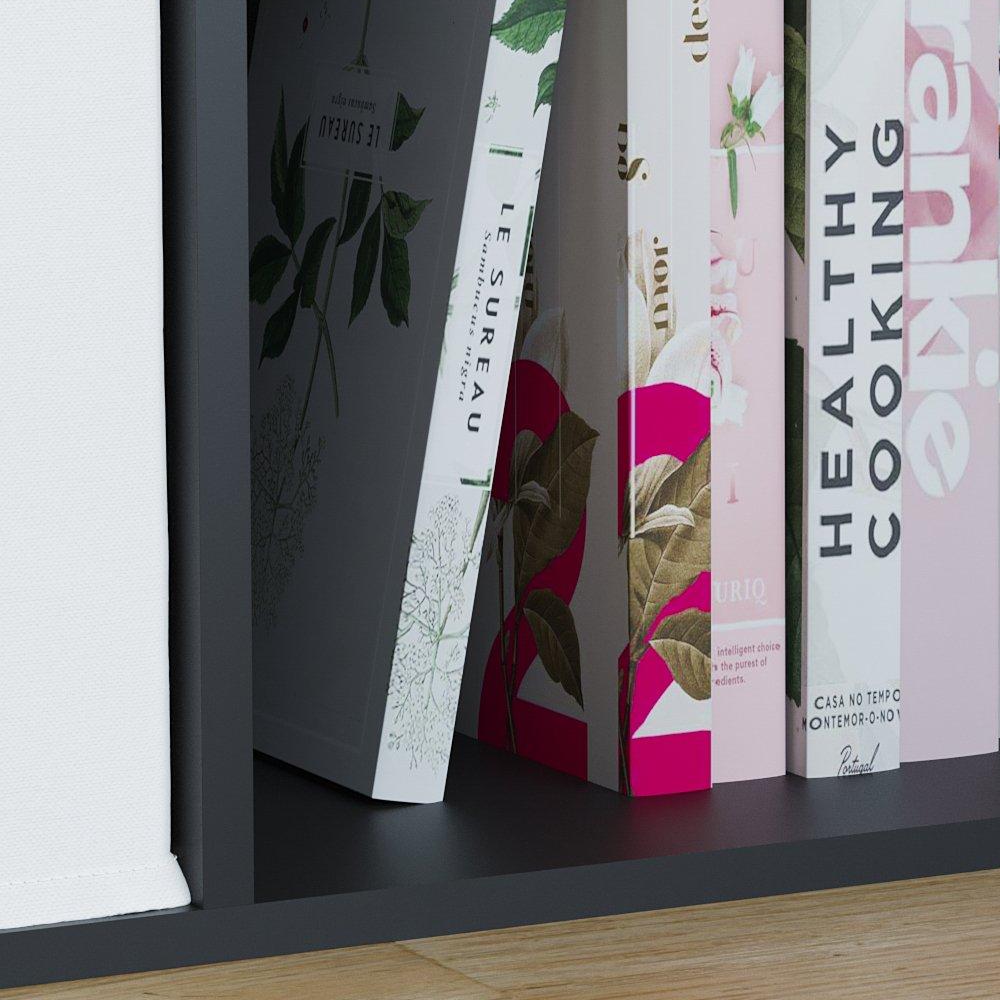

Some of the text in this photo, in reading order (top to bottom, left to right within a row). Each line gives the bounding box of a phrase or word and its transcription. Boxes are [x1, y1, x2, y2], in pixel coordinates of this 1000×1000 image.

[317, 115, 381, 149] LE SUREAU
[457, 230, 492, 402] Sambucus nigra
[466, 203, 516, 434] LE SUREAU
[820, 125, 857, 558] HEALTHY
[868, 119, 905, 559] COOKING
[717, 641, 782, 658] intelligent choice
[721, 661, 733, 672] the
[735, 658, 759, 673] purest
[760, 657, 768, 667] of
[814, 689, 901, 710] CASA NO TEMPO
[837, 742, 881, 776] Portugal
